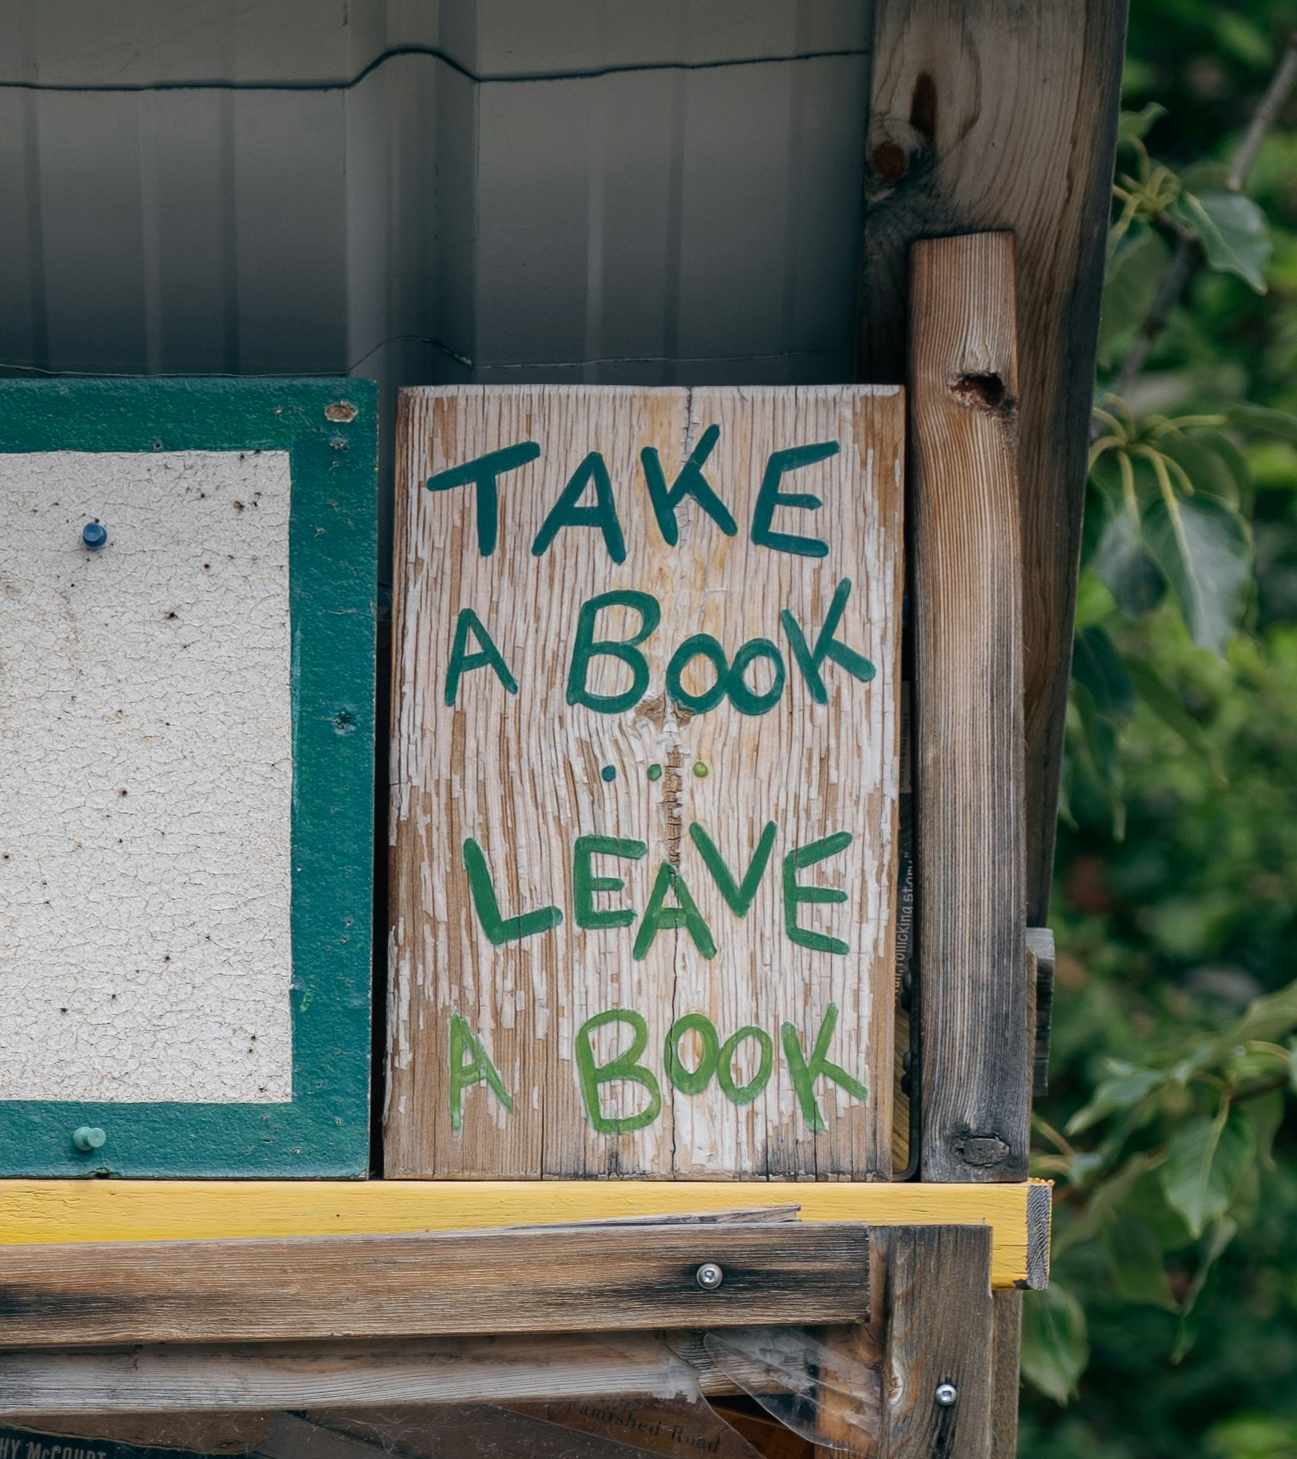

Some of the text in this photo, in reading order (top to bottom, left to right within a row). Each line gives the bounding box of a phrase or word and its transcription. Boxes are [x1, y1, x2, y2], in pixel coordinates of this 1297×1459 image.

[426, 422, 840, 566] TAKE
[444, 577, 877, 716] A BOOK
[463, 820, 853, 962] LEAVE
[448, 1001, 869, 1135] A BOOK
